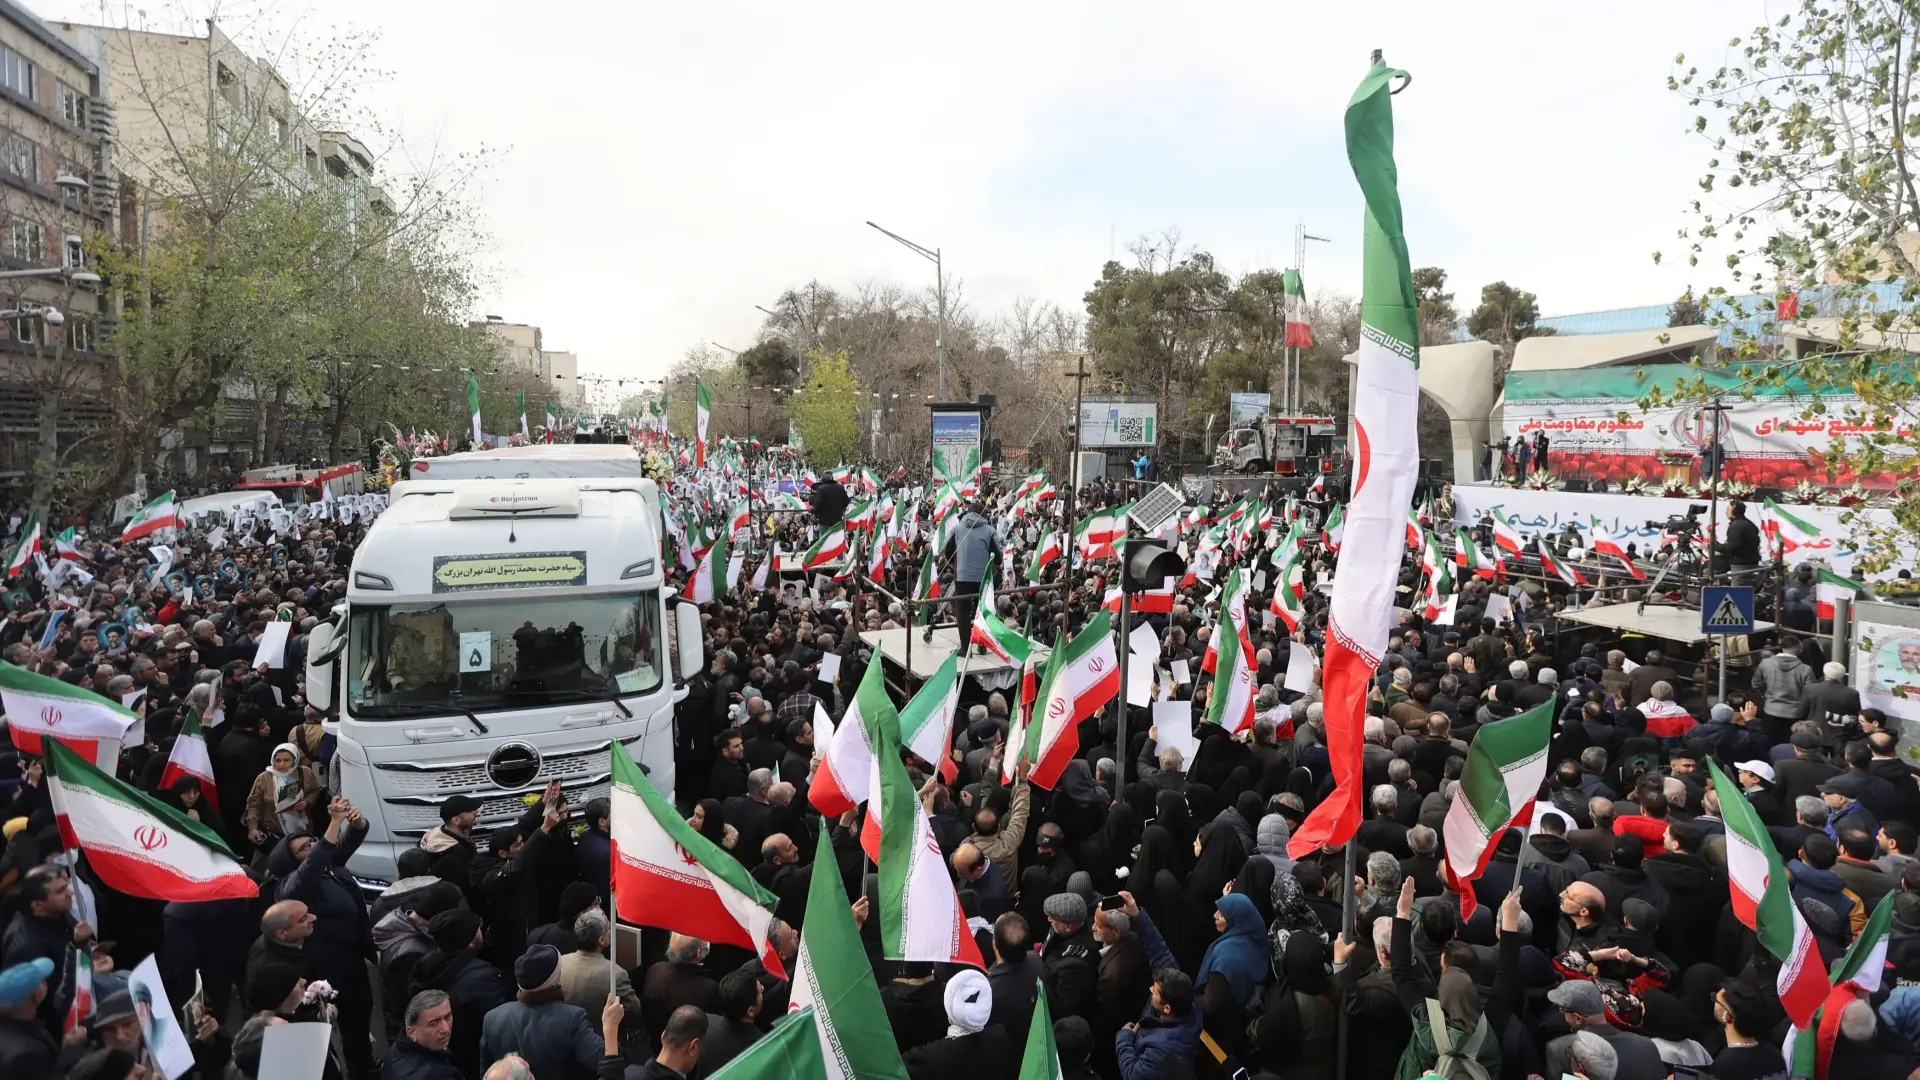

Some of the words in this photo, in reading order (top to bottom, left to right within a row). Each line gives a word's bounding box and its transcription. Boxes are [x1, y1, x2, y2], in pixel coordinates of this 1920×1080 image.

[1518, 417, 1542, 433] ملی
[1543, 416, 1596, 433] مقاومت
[1588, 435, 1613, 446] حوادث
[1613, 436, 1621, 445] در
[463, 568, 483, 578] تهران
[484, 567, 496, 575] الله
[497, 566, 516, 576] رسول
[516, 565, 537, 573] محمد
[539, 564, 561, 574] حضرت
[562, 563, 576, 573] سپاه
[443, 569, 463, 579] بزرگ
[469, 648, 482, 667] ۵
